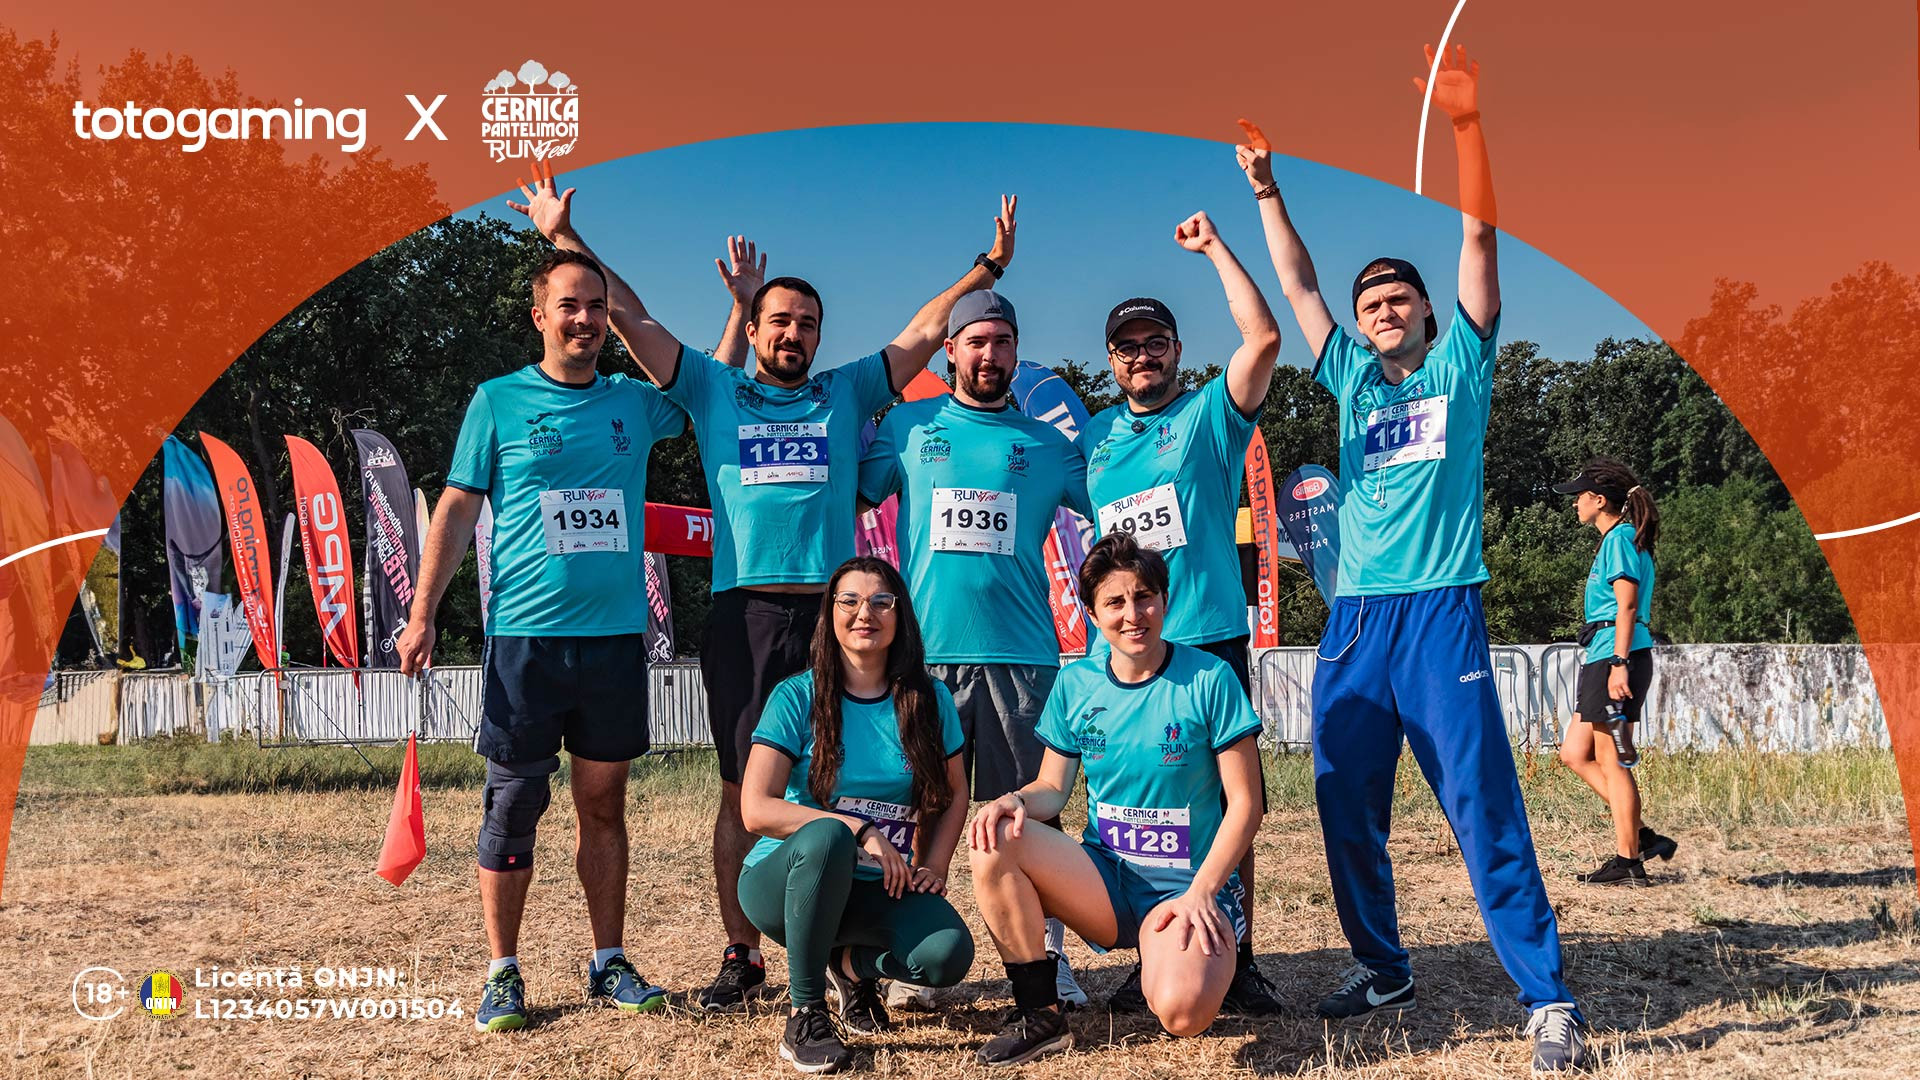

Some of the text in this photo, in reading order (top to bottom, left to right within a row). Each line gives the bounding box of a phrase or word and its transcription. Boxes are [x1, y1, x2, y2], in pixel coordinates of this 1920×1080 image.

[767, 424, 799, 433] CERNICA
[1375, 418, 1436, 452] 1119
[750, 441, 819, 463] 1123
[920, 445, 951, 454] CERNICA
[553, 509, 620, 531] 1934
[684, 514, 714, 542] FI
[941, 508, 1008, 532] 1936
[1459, 669, 1490, 683] adidas
[1158, 743, 1188, 755] RUN
[866, 801, 898, 814] CERNICA
[1122, 808, 1158, 819] CERNICA
[1107, 826, 1179, 853] 1128
